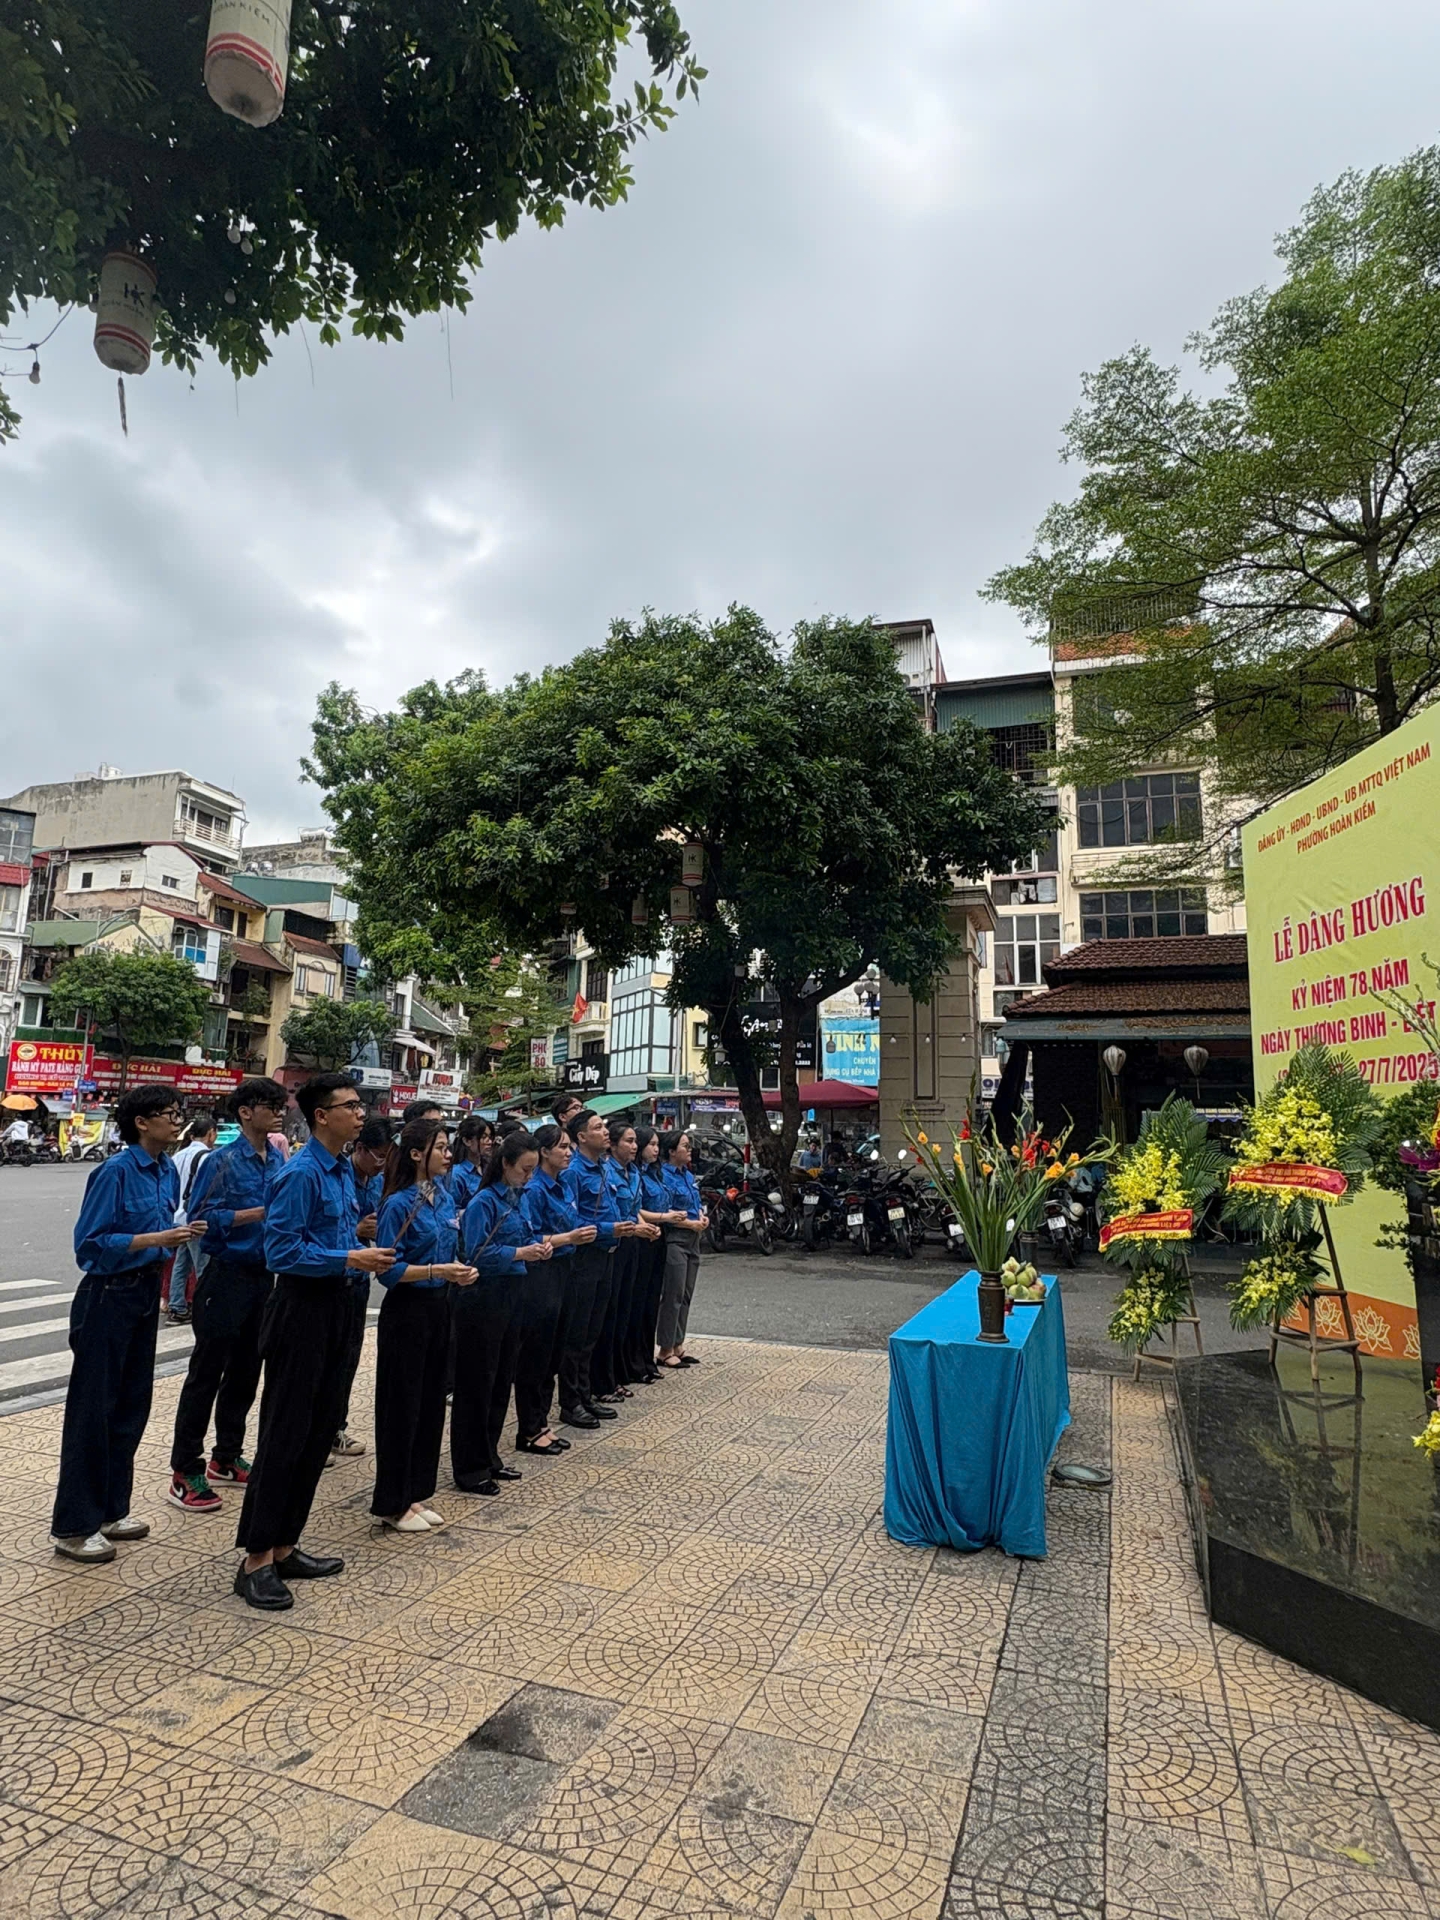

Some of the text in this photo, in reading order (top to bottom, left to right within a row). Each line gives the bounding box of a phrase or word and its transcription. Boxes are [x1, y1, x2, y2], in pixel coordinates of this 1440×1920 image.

[1258, 834, 1276, 852] ĐẢNG
[1276, 825, 1286, 841] ỦY
[1290, 812, 1311, 835] HĐND
[1316, 796, 1339, 821] UBND
[1344, 786, 1357, 804] UB
[1358, 771, 1383, 797] MTTQ
[1384, 757, 1404, 781] VIỆT
[1406, 741, 1431, 769] NAM
[1297, 799, 1376, 854] PHƯỜNG HOÀN KIẾM
[1274, 876, 1425, 963] LỄ DÂNG HƯƠNG
[1291, 957, 1409, 1011] KỶ NIỆM 78 NĂM
[40, 1045, 85, 1060] THỦY
[1261, 1026, 1291, 1055] NGÀY
[1294, 1019, 1347, 1050] THƯƠNG
[1350, 1011, 1387, 1042] BINH
[1359, 1052, 1439, 1084] 27/7/2025
